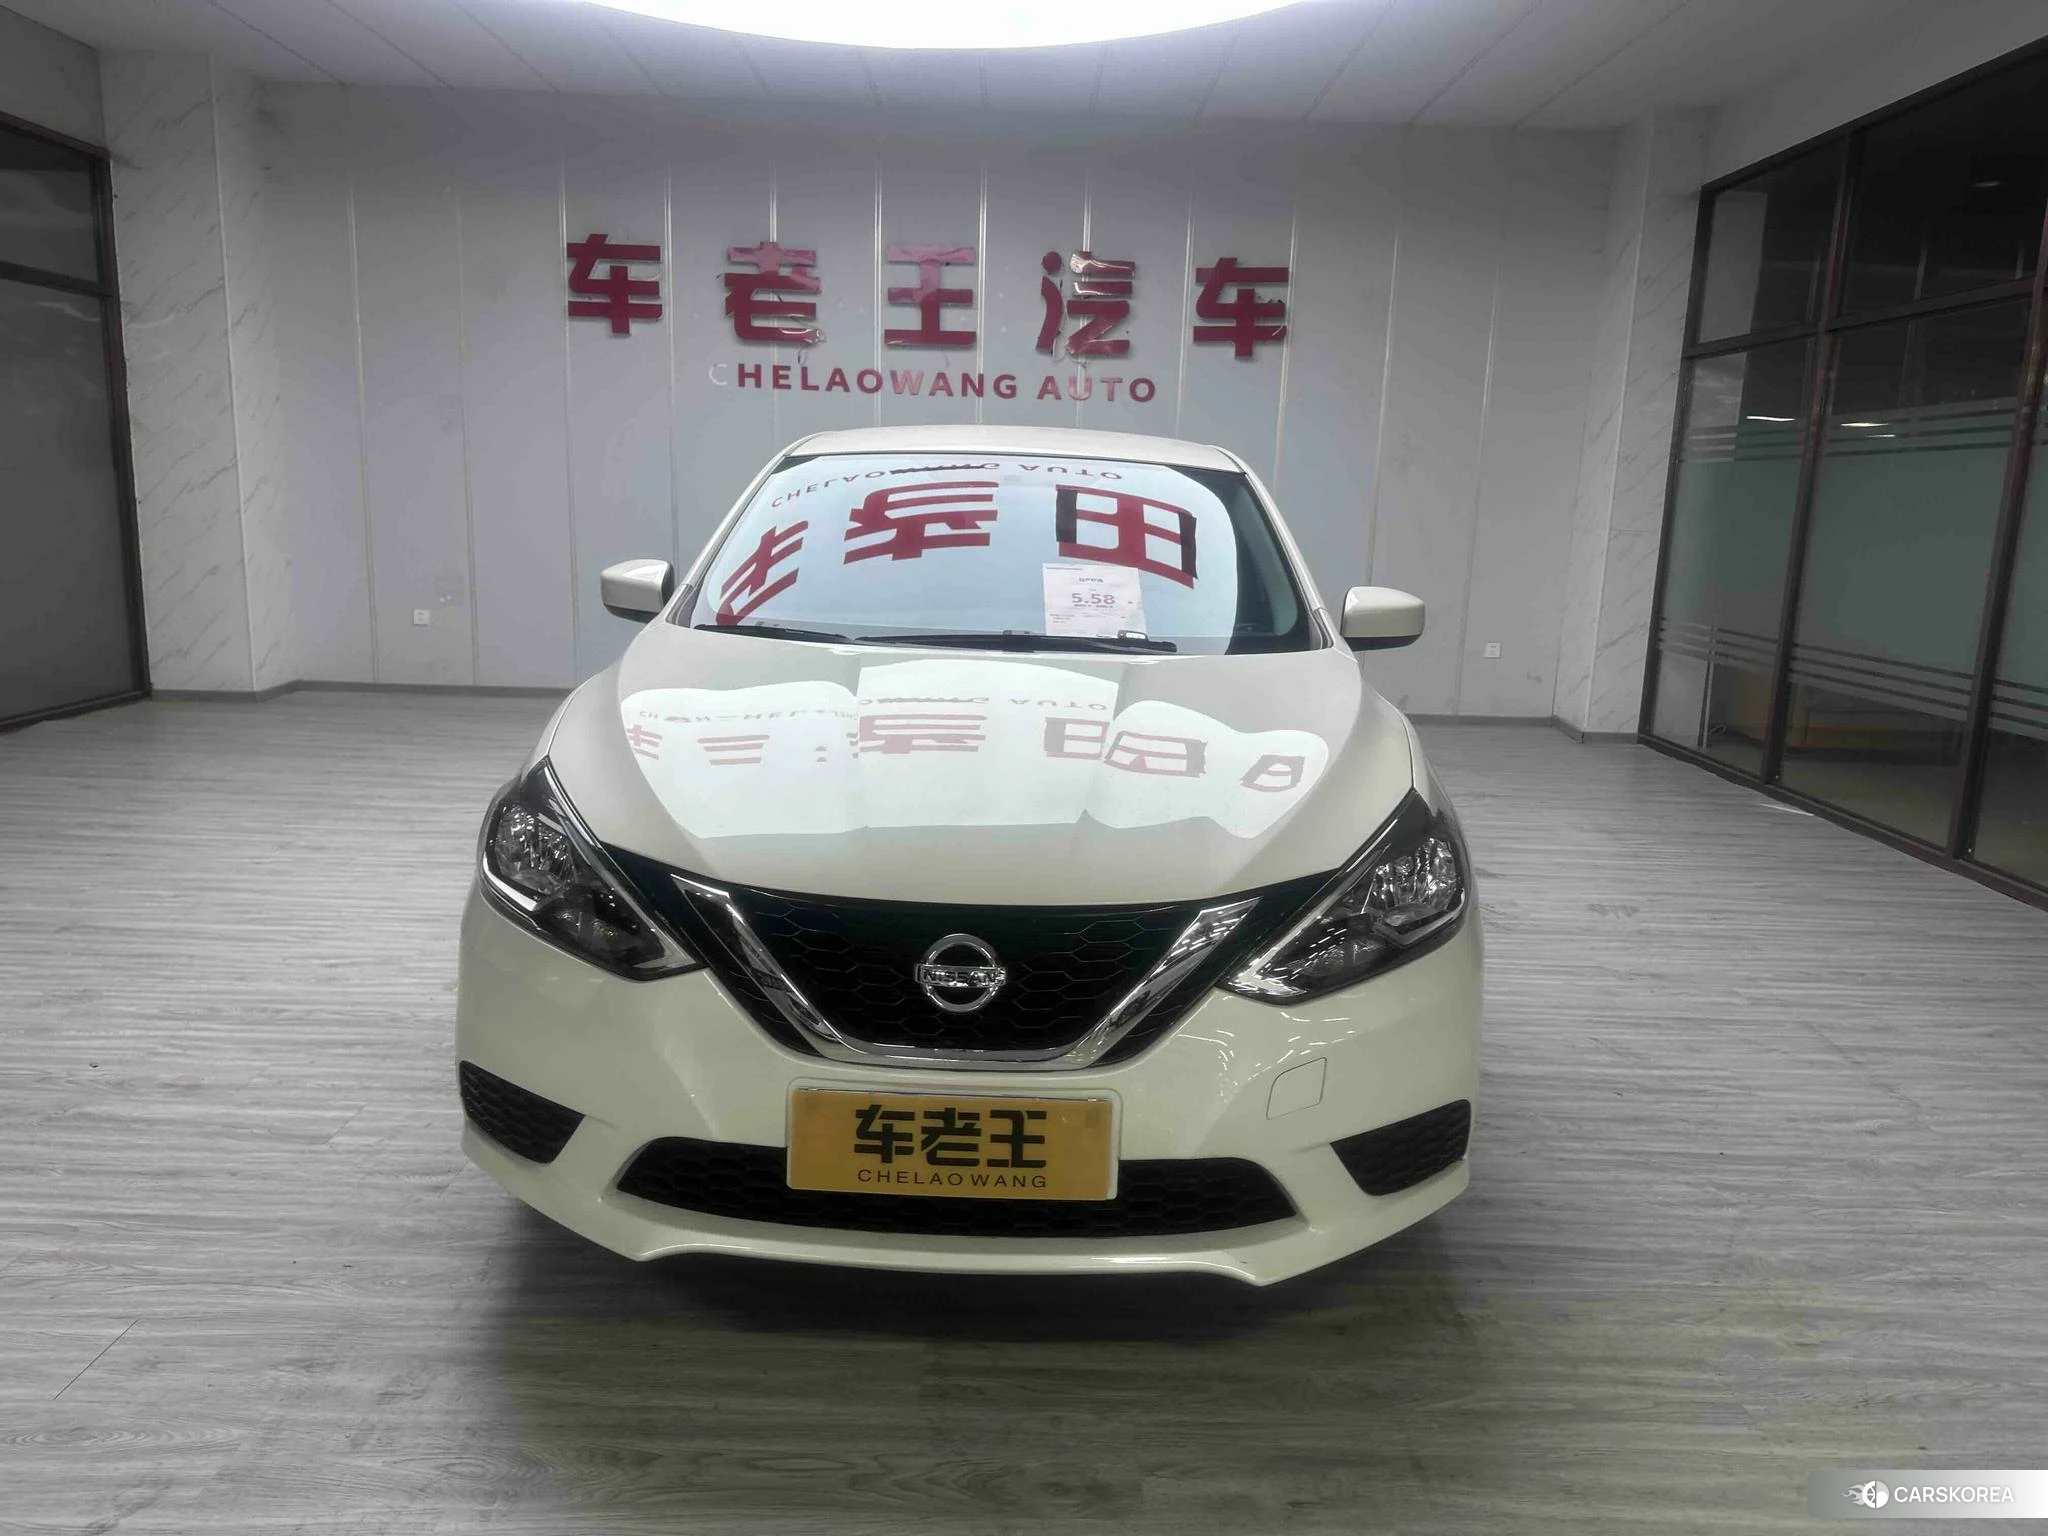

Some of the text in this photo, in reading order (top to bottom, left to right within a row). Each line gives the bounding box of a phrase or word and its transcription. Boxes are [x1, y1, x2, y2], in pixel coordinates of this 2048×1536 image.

[566, 233, 1290, 359] 车老王汽车
[708, 362, 1156, 402] CHELAOWANG AUTO
[1071, 592, 1116, 605] 5.58
[853, 1103, 1048, 1169] 车老王
[857, 1168, 1047, 1189] CHELAOWANG
